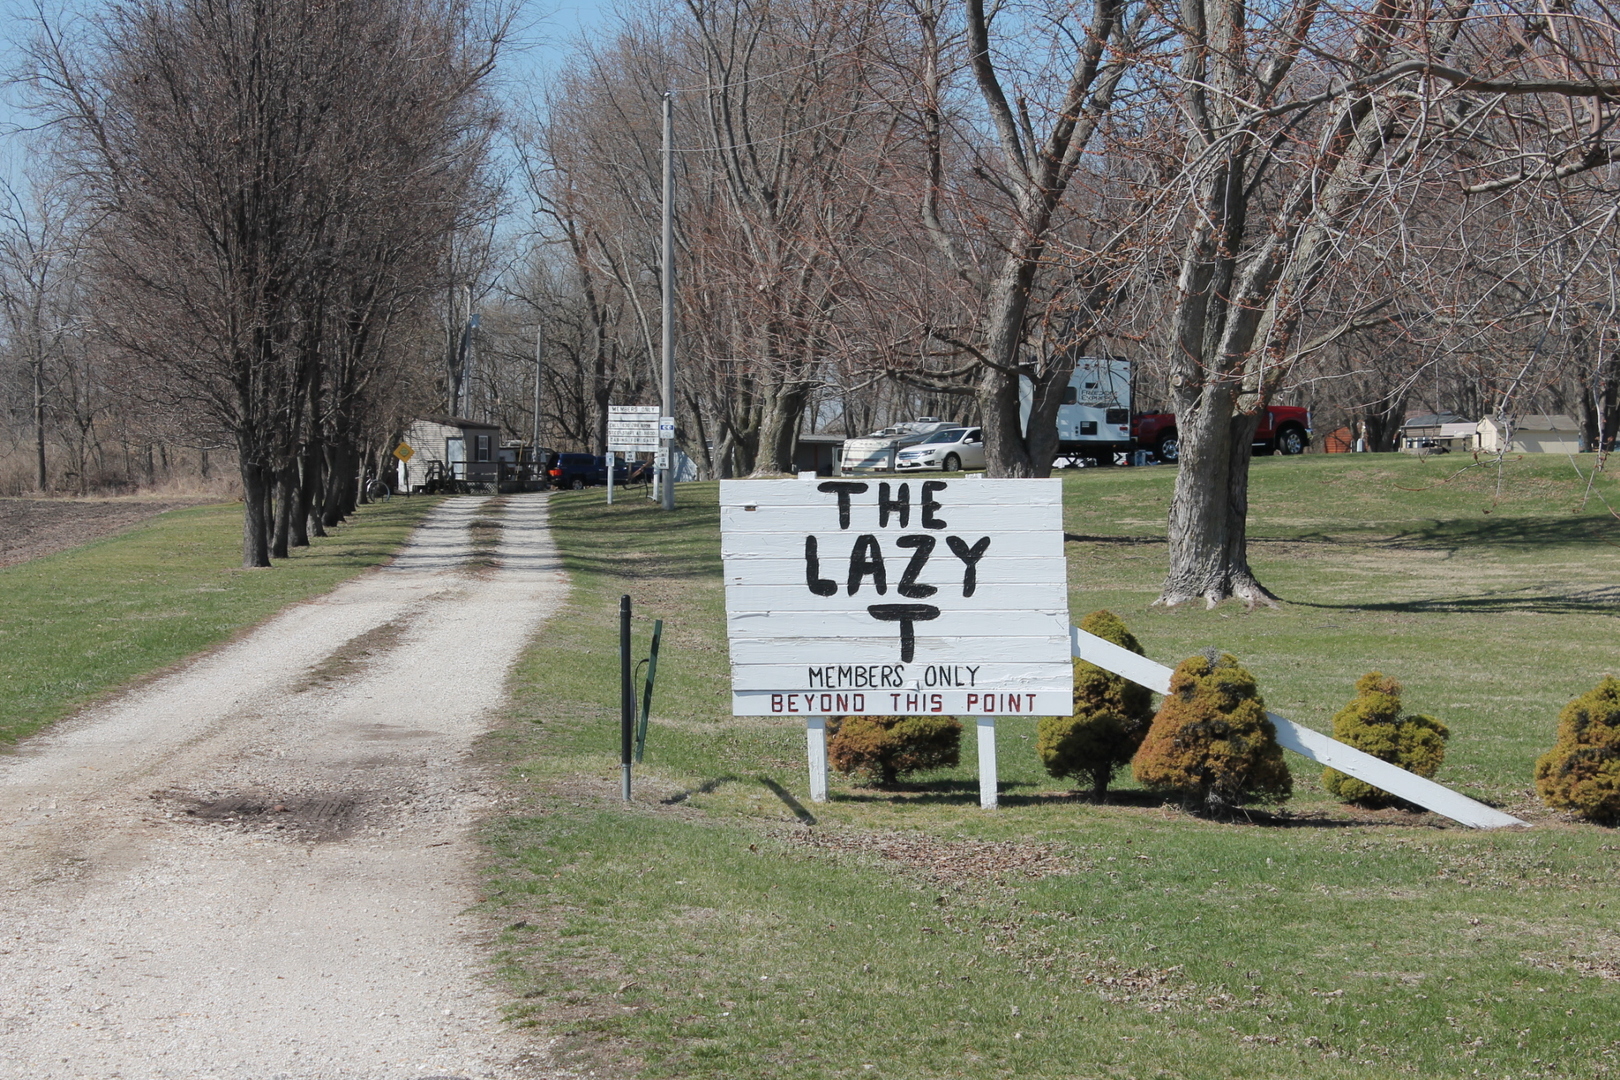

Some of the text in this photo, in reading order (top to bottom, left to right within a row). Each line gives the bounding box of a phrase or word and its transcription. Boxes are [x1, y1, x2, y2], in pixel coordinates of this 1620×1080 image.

[817, 480, 948, 530] THE
[804, 534, 991, 599] LAZY
[867, 603, 941, 664] T
[808, 665, 980, 689] MEMBERS ONLY
[771, 693, 1037, 713] BEYOND THIS POINT
